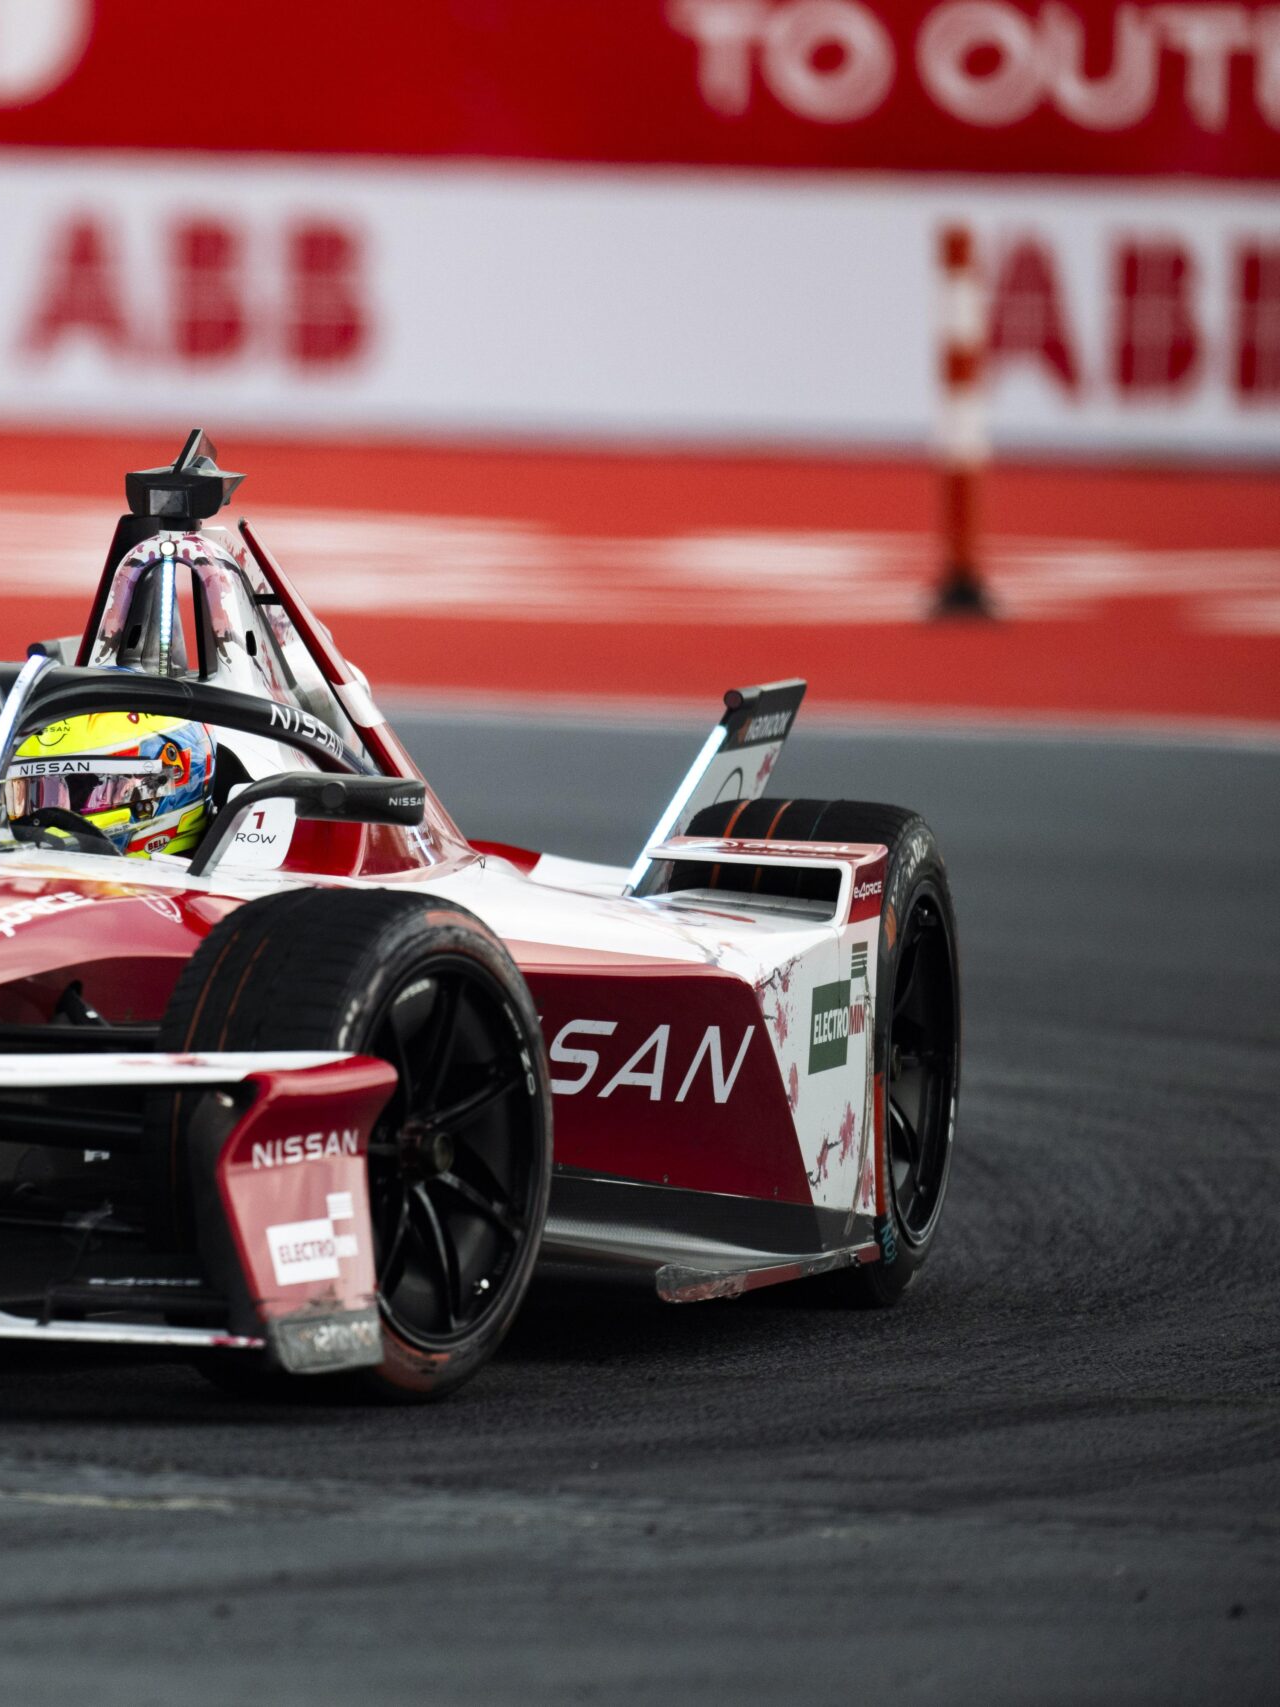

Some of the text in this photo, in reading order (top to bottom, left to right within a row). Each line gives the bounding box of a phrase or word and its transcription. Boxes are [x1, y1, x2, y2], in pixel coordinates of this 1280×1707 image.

[664, 0, 1280, 134] TO OUT
[6, 211, 370, 370] ABB
[271, 703, 345, 760] NISSAN
[20, 761, 90, 775] NISSAN
[235, 832, 277, 845] ROW
[253, 811, 266, 829] 1
[147, 837, 169, 851] BELL
[537, 1015, 756, 1105] SAN
[252, 1129, 359, 1169] NISSAN
